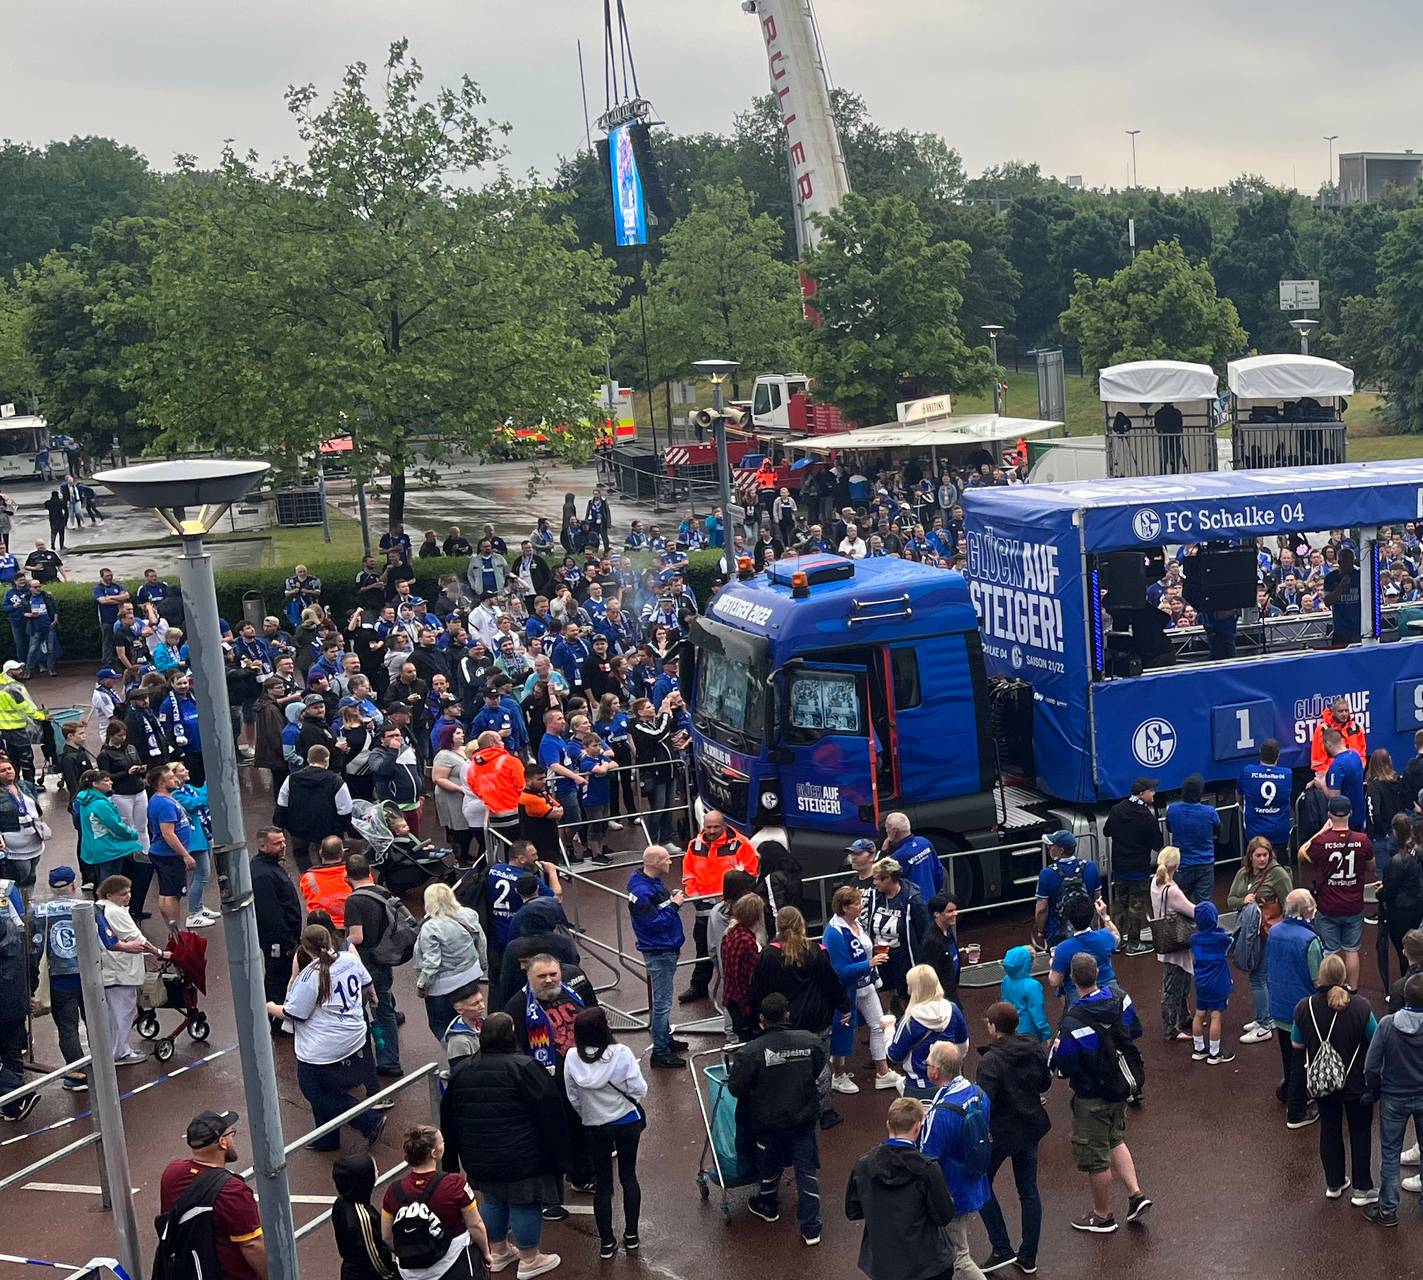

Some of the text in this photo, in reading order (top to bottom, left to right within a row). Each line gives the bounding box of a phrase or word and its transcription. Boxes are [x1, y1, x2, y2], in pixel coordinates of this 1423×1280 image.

[1166, 503, 1305, 533] FC Schalke 04
[967, 526, 1060, 596] GLÜCK AUF
[713, 593, 773, 627] AUFSTEIGER 2022
[970, 581, 1064, 653] STEIGER!
[1026, 654, 1065, 674] SAISON 21/22
[1236, 708, 1254, 750] 1
[797, 796, 841, 815] STEIGER!
[823, 786, 840, 800] AUF
[1260, 781, 1277, 807] 9
[1328, 850, 1357, 879] 21
[493, 879, 511, 910] 2
[333, 974, 360, 1014] 19
